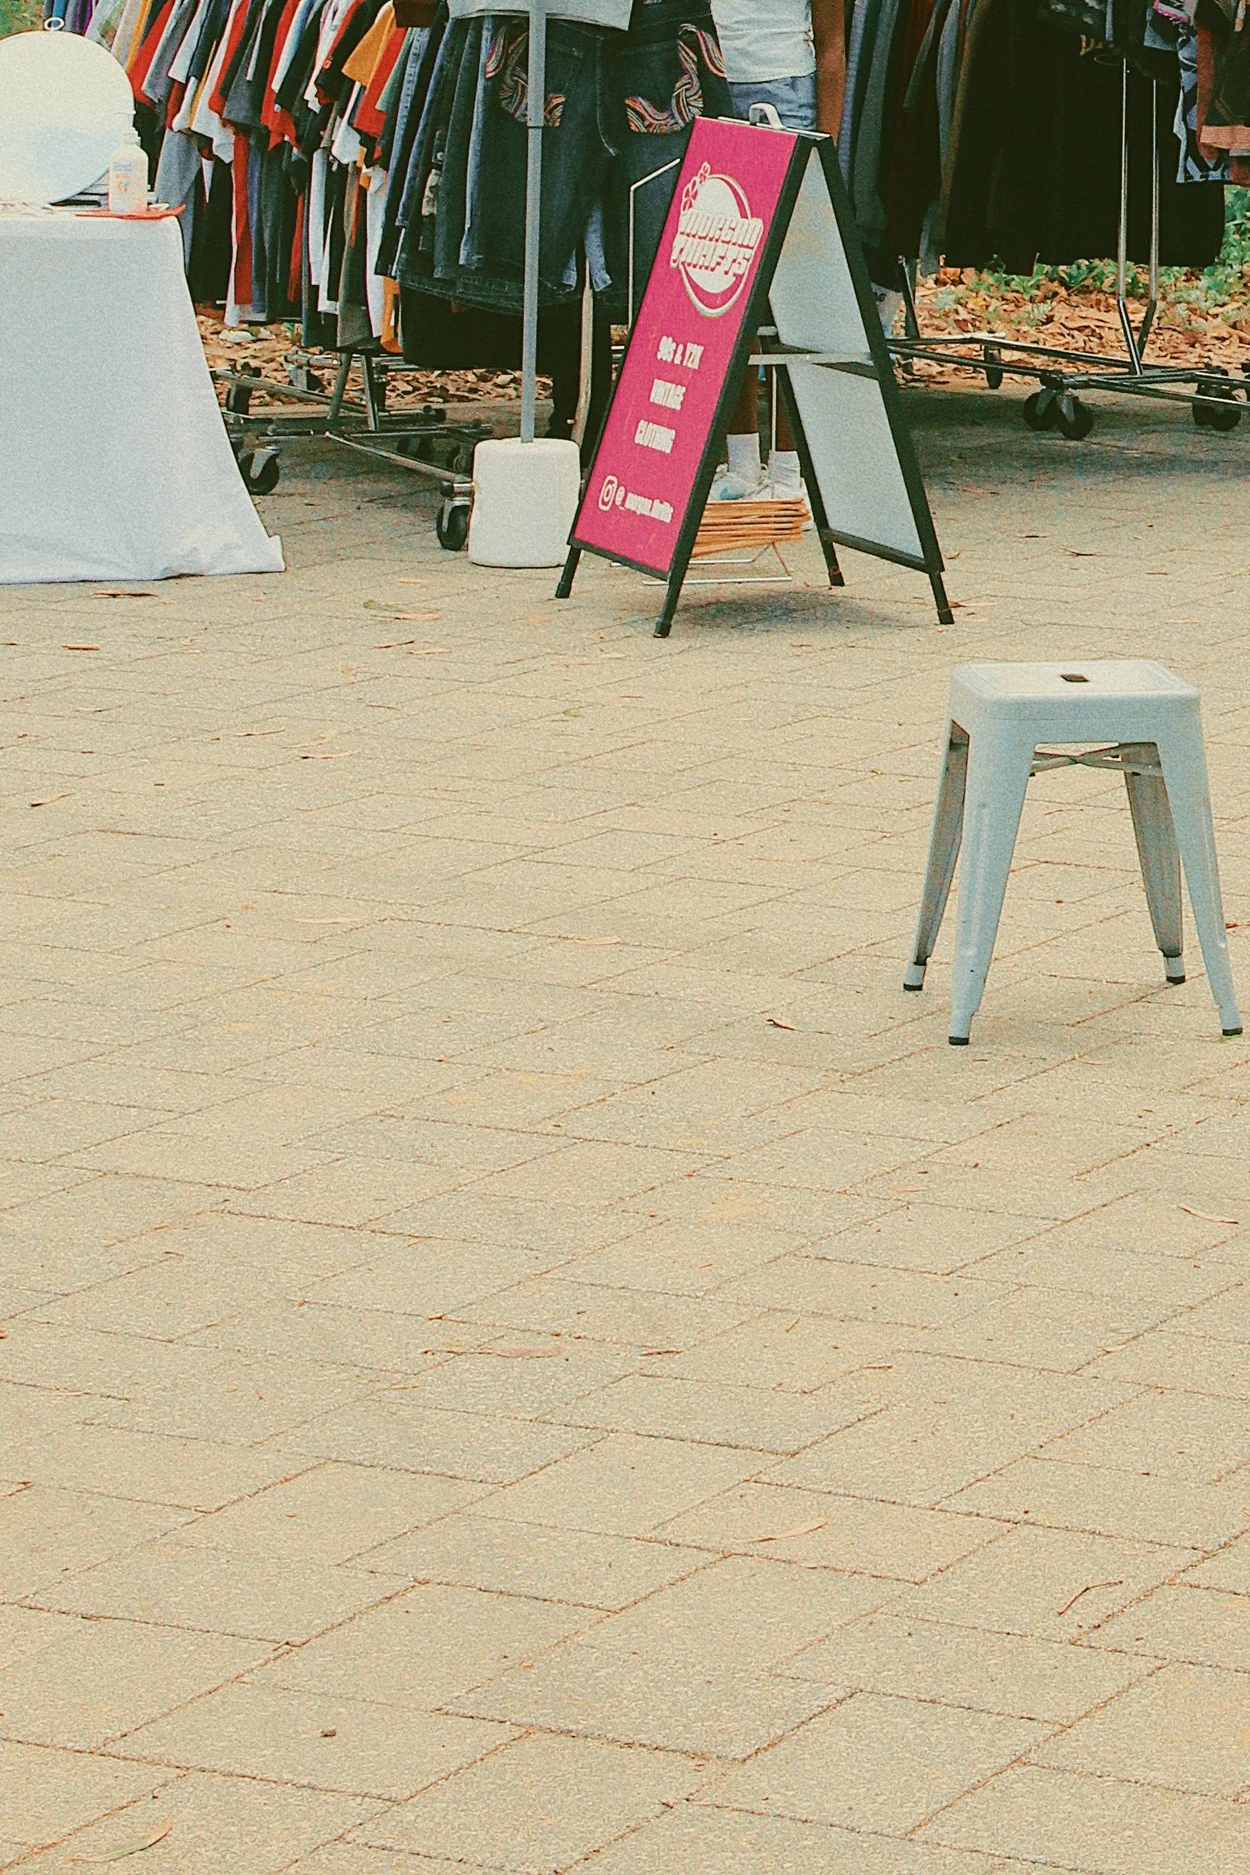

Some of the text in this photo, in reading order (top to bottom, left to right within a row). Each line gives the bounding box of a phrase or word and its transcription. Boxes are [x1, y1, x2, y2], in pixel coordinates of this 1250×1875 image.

[670, 238, 754, 275] THRIFTS
[683, 342, 704, 370] Y2K
[649, 378, 686, 411] VINTAGE
[634, 419, 676, 454] CLOTHING
